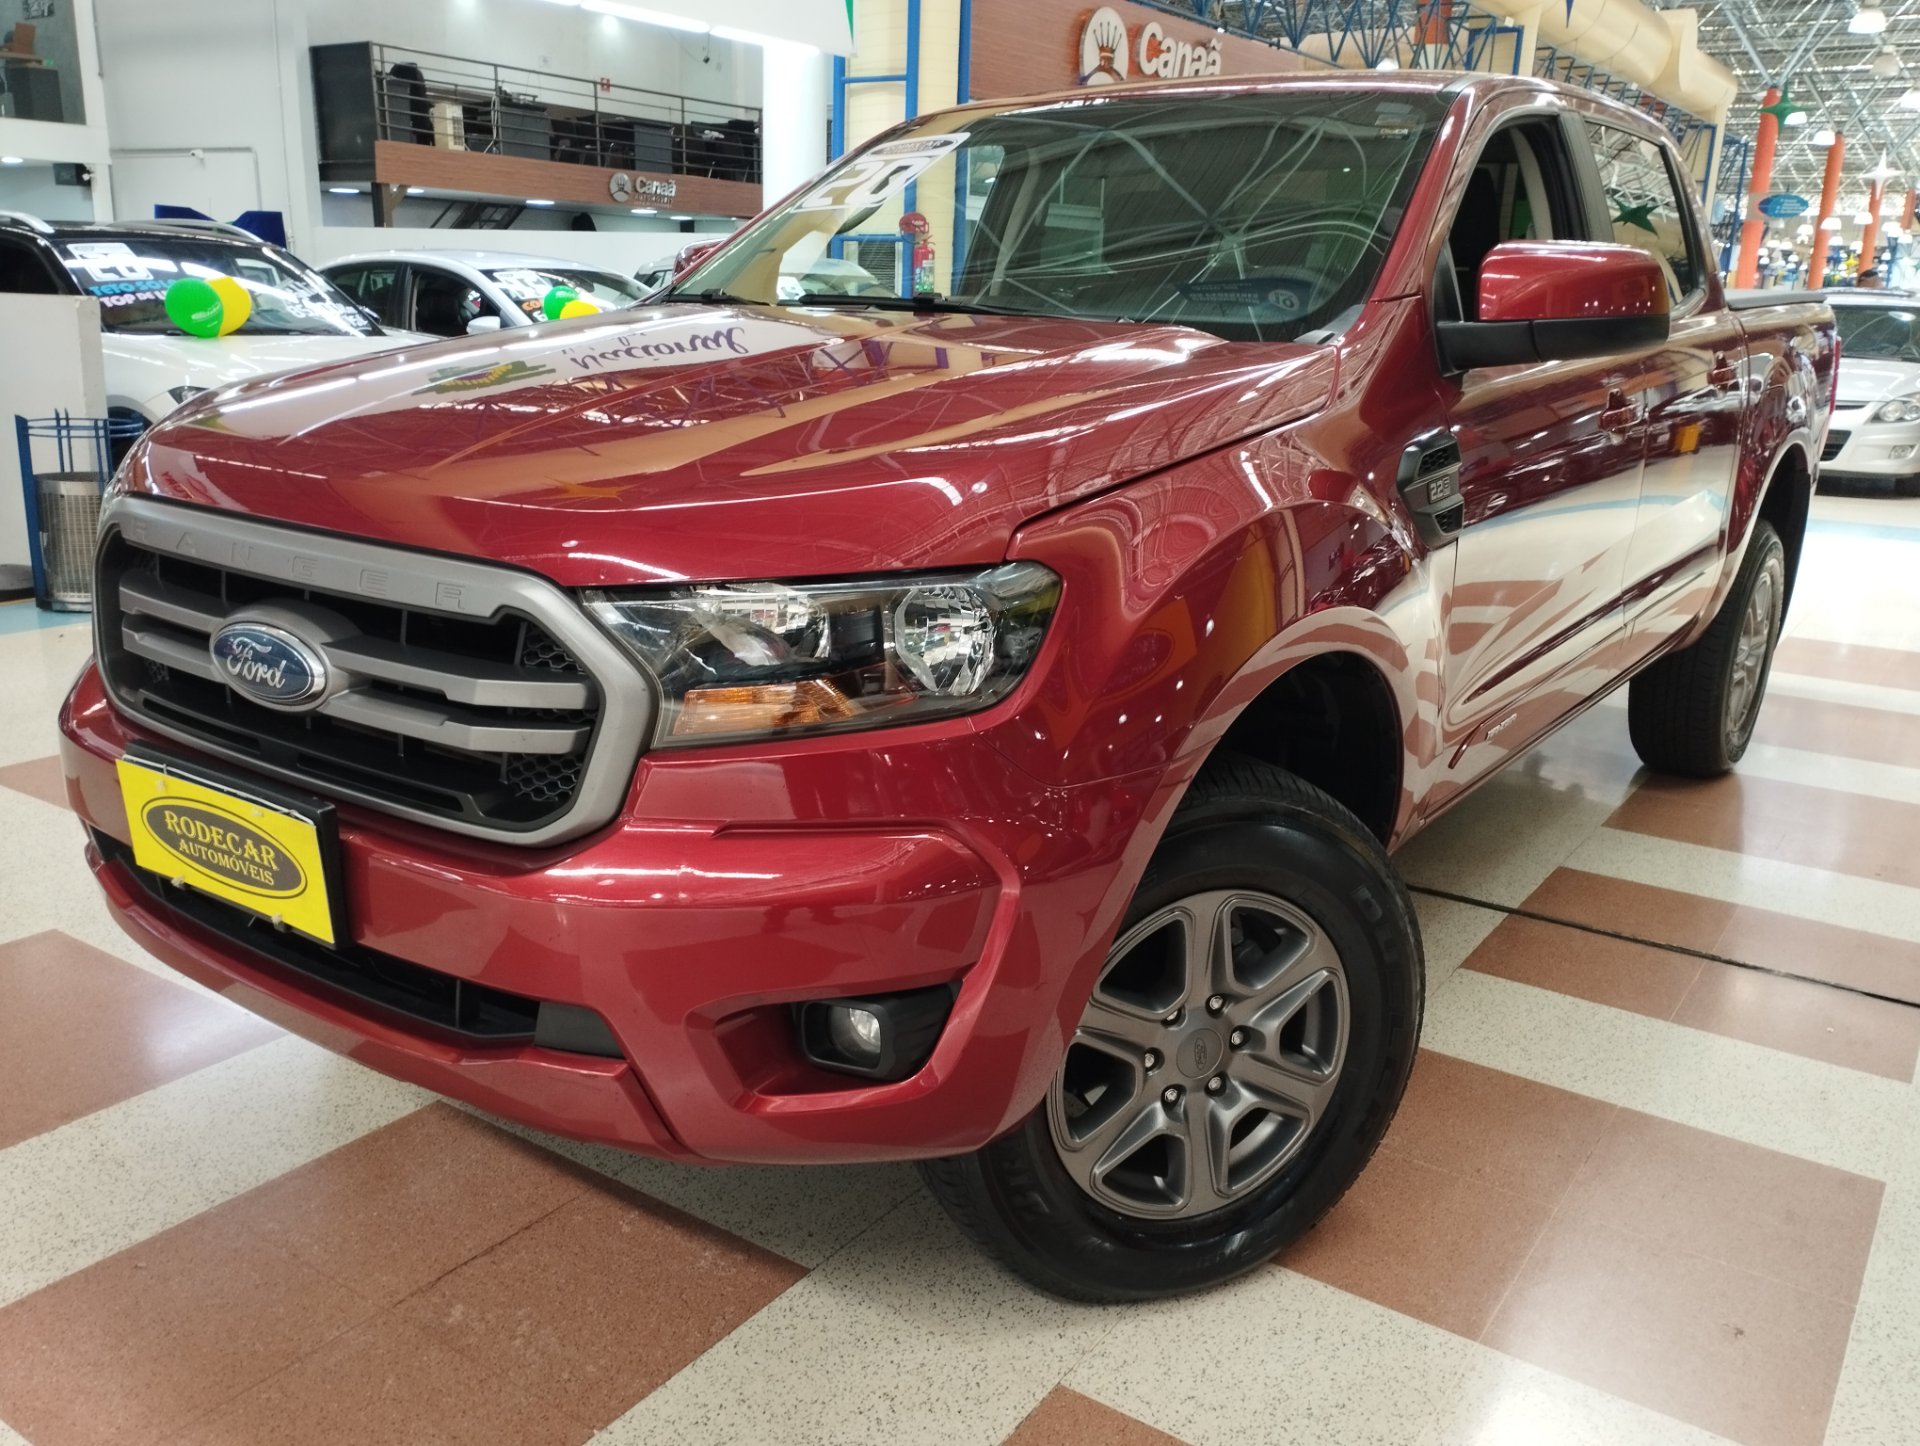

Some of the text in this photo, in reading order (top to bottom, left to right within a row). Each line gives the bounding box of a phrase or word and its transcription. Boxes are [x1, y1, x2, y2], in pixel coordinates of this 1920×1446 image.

[1139, 22, 1223, 78] Canaã
[635, 176, 677, 197] Canaã
[89, 283, 135, 296] TETO
[100, 293, 136, 308] TOP
[128, 517, 467, 610] RANGER
[227, 637, 287, 688] Ford
[164, 810, 280, 871] RODECAR
[178, 838, 275, 886] AUTOMÓVEIS
